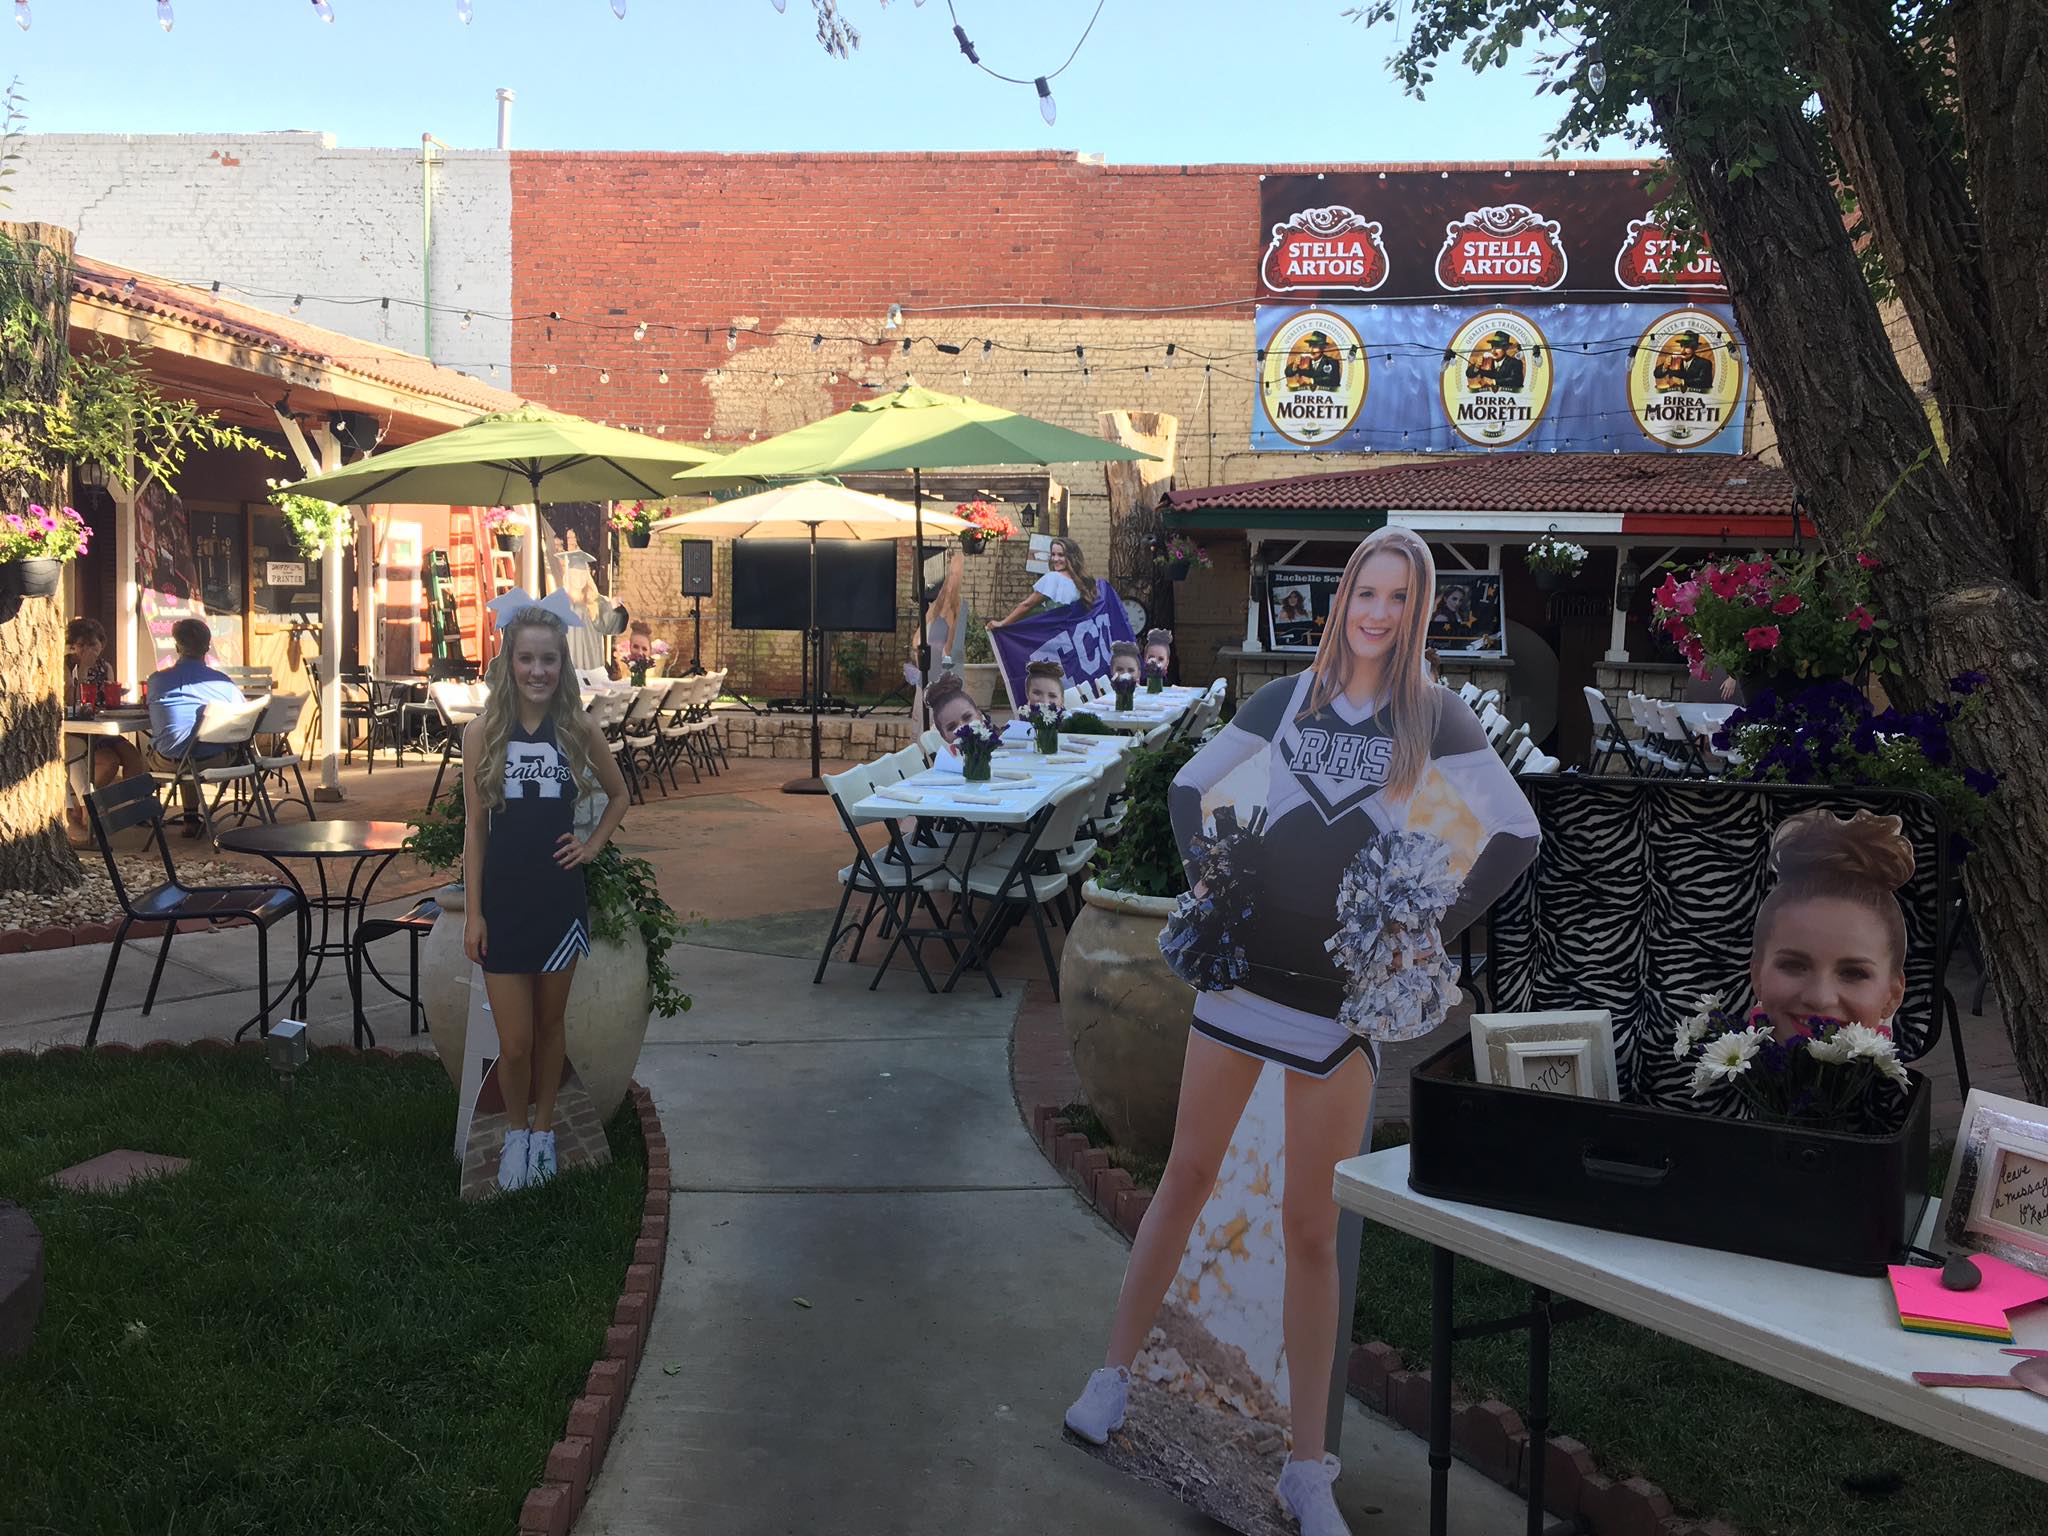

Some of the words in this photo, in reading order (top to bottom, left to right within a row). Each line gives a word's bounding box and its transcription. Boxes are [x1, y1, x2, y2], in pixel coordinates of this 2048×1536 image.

[1288, 241, 1364, 258] STELLA
[1463, 240, 1541, 257] STELLA
[1286, 259, 1364, 275] ARTOIS
[1461, 258, 1541, 275] ARTOIS
[1294, 394, 1334, 404] BIRRA
[1475, 396, 1516, 405] BIRRA
[1663, 396, 1705, 406] BIRRA
[1276, 402, 1349, 419] MORETTI
[1457, 403, 1532, 420] MORETTI
[1644, 404, 1721, 422] MORETTI
[1289, 728, 1392, 786] RHS
[504, 758, 571, 781] Raiders
